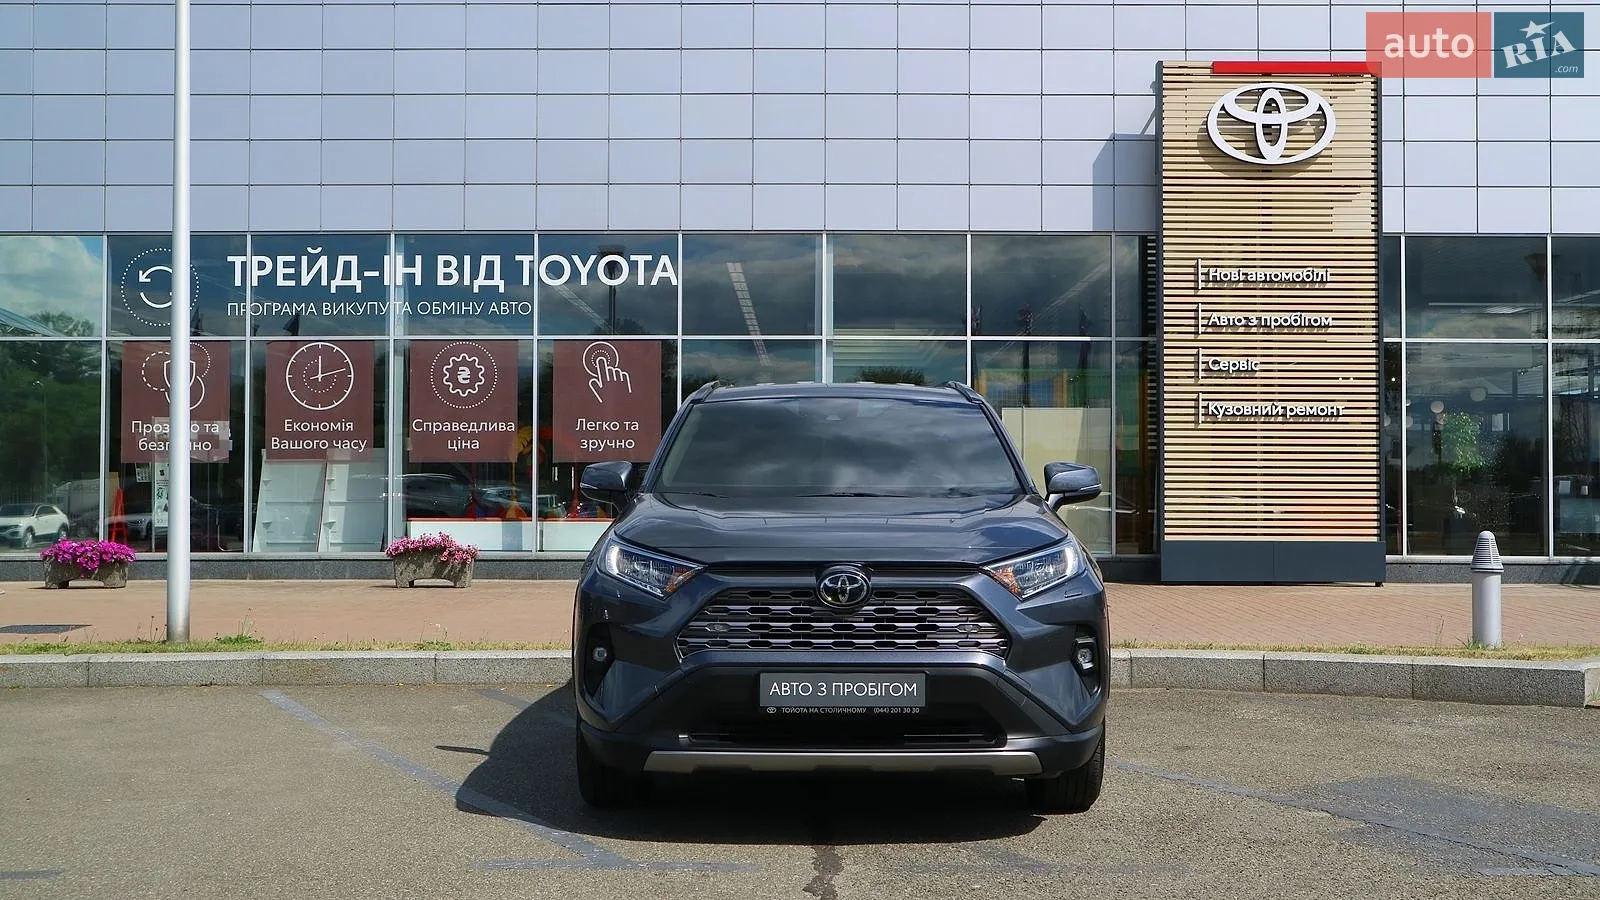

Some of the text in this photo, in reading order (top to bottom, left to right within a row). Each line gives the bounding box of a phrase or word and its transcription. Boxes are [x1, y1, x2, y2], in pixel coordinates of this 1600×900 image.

[227, 247, 678, 293] ТРЕЙД-ІН ВІД TOYOTA
[1208, 267, 1331, 282] Нові автомобілі
[227, 301, 532, 316] ПРОГРАМА ВИКУПУ ТА ОБМІНУ АВТО
[1208, 312, 1333, 329] Авто з пробігом
[1208, 357, 1261, 373] Сервіс
[1208, 401, 1345, 418] Кузовний ремонт
[131, 420, 220, 436] Прозо та
[284, 418, 354, 432] Економія
[412, 418, 516, 434] Справедлива
[575, 418, 640, 431] Легко та
[138, 437, 213, 451] безно
[271, 436, 368, 452] Вашого часу
[447, 436, 480, 451] ціна
[580, 439, 636, 452] зручно
[769, 682, 813, 697] АВТО
[832, 682, 917, 697] ПРОБІГОМ
[782, 705, 920, 714] ТОЙОТА НА СТОЛИЧНОМУ (044) 201 30 30
